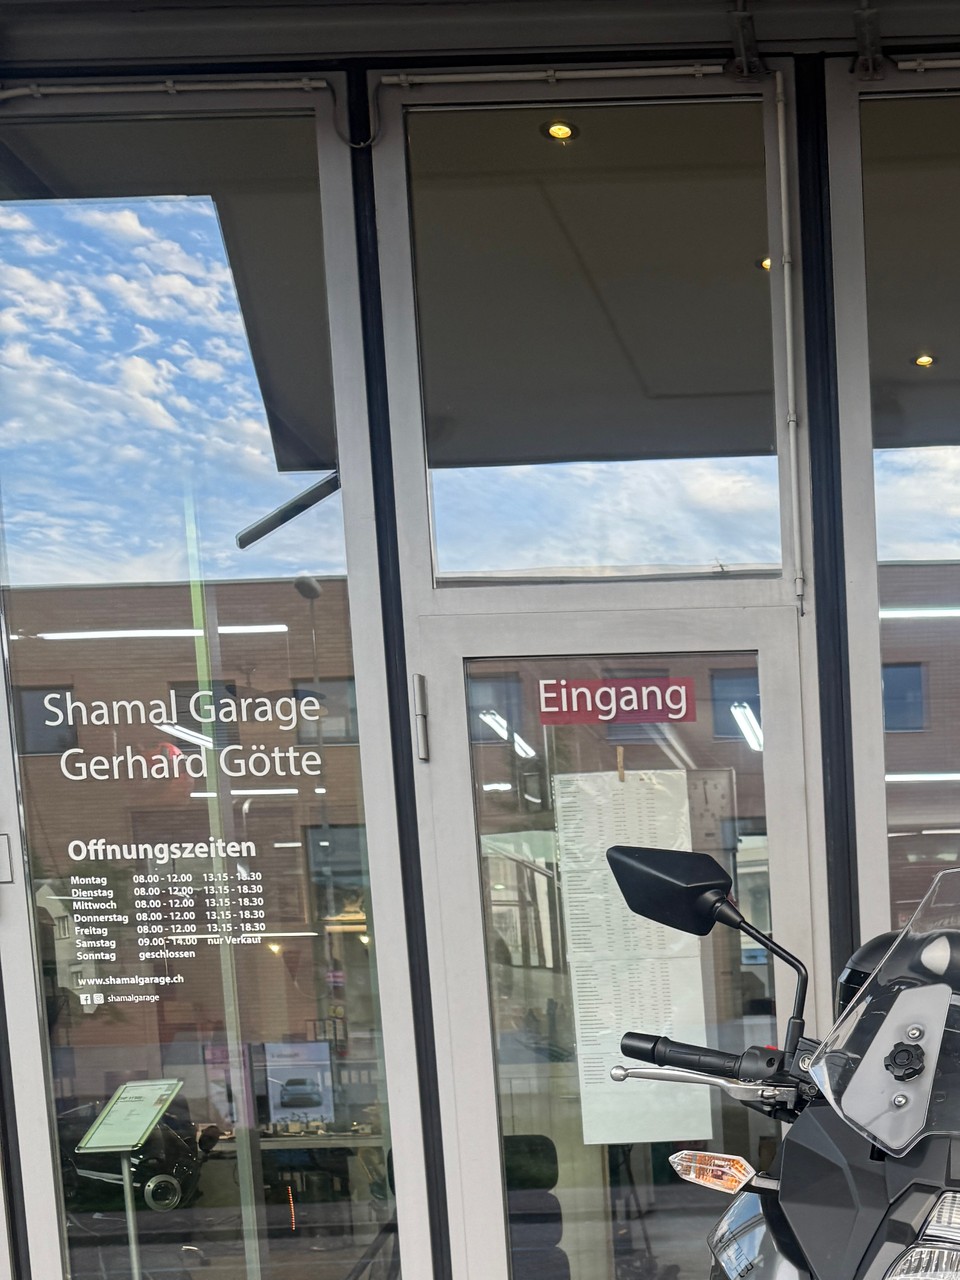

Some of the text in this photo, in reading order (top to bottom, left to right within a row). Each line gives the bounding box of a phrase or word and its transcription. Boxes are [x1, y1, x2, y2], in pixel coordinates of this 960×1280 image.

[539, 680, 687, 720] Eingang
[44, 690, 320, 730] Shamal Garage
[60, 744, 322, 781] Gerhard Götte
[71, 876, 107, 886] Montag
[133, 874, 159, 883] 08.00
[167, 874, 193, 882] 12.00
[203, 873, 228, 882] 13.15
[237, 872, 262, 881] 18.30
[72, 889, 114, 898] Dienstag
[134, 887, 160, 896] 08.00
[168, 886, 194, 895] 12.00
[204, 886, 229, 894] 13.15
[237, 885, 263, 894] 18.30
[73, 901, 117, 910] Mittwoch
[135, 900, 161, 909] 08.00
[169, 899, 194, 908] 12.00
[205, 898, 230, 907] 13.15
[238, 898, 264, 906] 18.30
[74, 914, 129, 924] Donnerstag
[136, 913, 162, 921] 08.00
[170, 912, 195, 921] 12.00
[206, 911, 231, 920] 13.15
[239, 910, 265, 919] 18.30
[75, 927, 108, 937] Freitag
[137, 925, 163, 934] 08.00
[171, 924, 196, 933] 12.00
[207, 924, 232, 932] 13.15
[240, 923, 266, 932] 18.30
[76, 939, 116, 949] Samstag
[138, 938, 164, 946] 09.00
[172, 937, 197, 946] 14.00
[225, 936, 262, 944] Verkauf
[77, 950, 195, 961] Sonntag geschlossen
[78, 974, 184, 986] www.shamalgarage.ch
[108, 994, 160, 1003] shamalgarage
